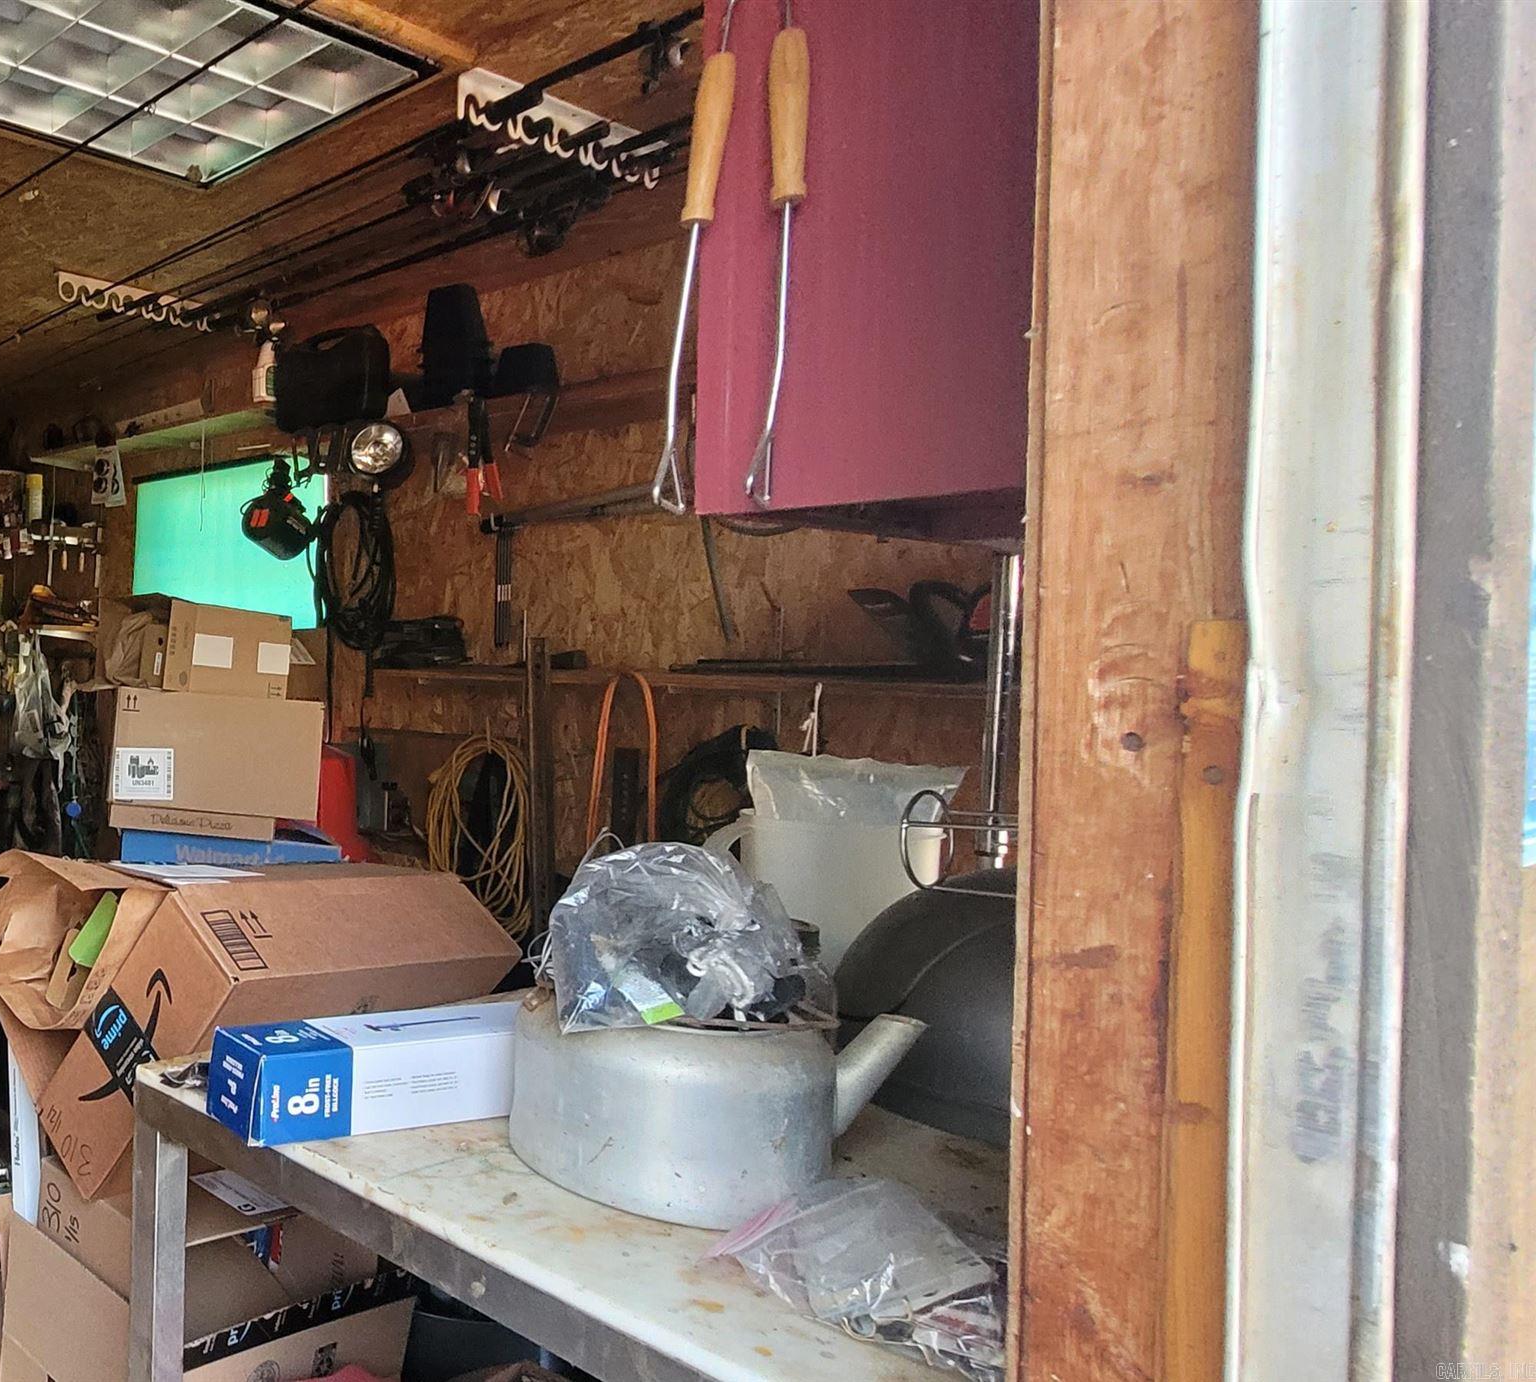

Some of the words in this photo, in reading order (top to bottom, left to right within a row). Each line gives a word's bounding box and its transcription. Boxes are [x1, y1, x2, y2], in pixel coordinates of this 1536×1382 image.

[199, 816, 234, 831] Pizza
[100, 1007, 128, 1051] prime
[287, 1077, 321, 1116] 8in
[41, 1182, 62, 1234] 310
[64, 1214, 82, 1245] 1/15
